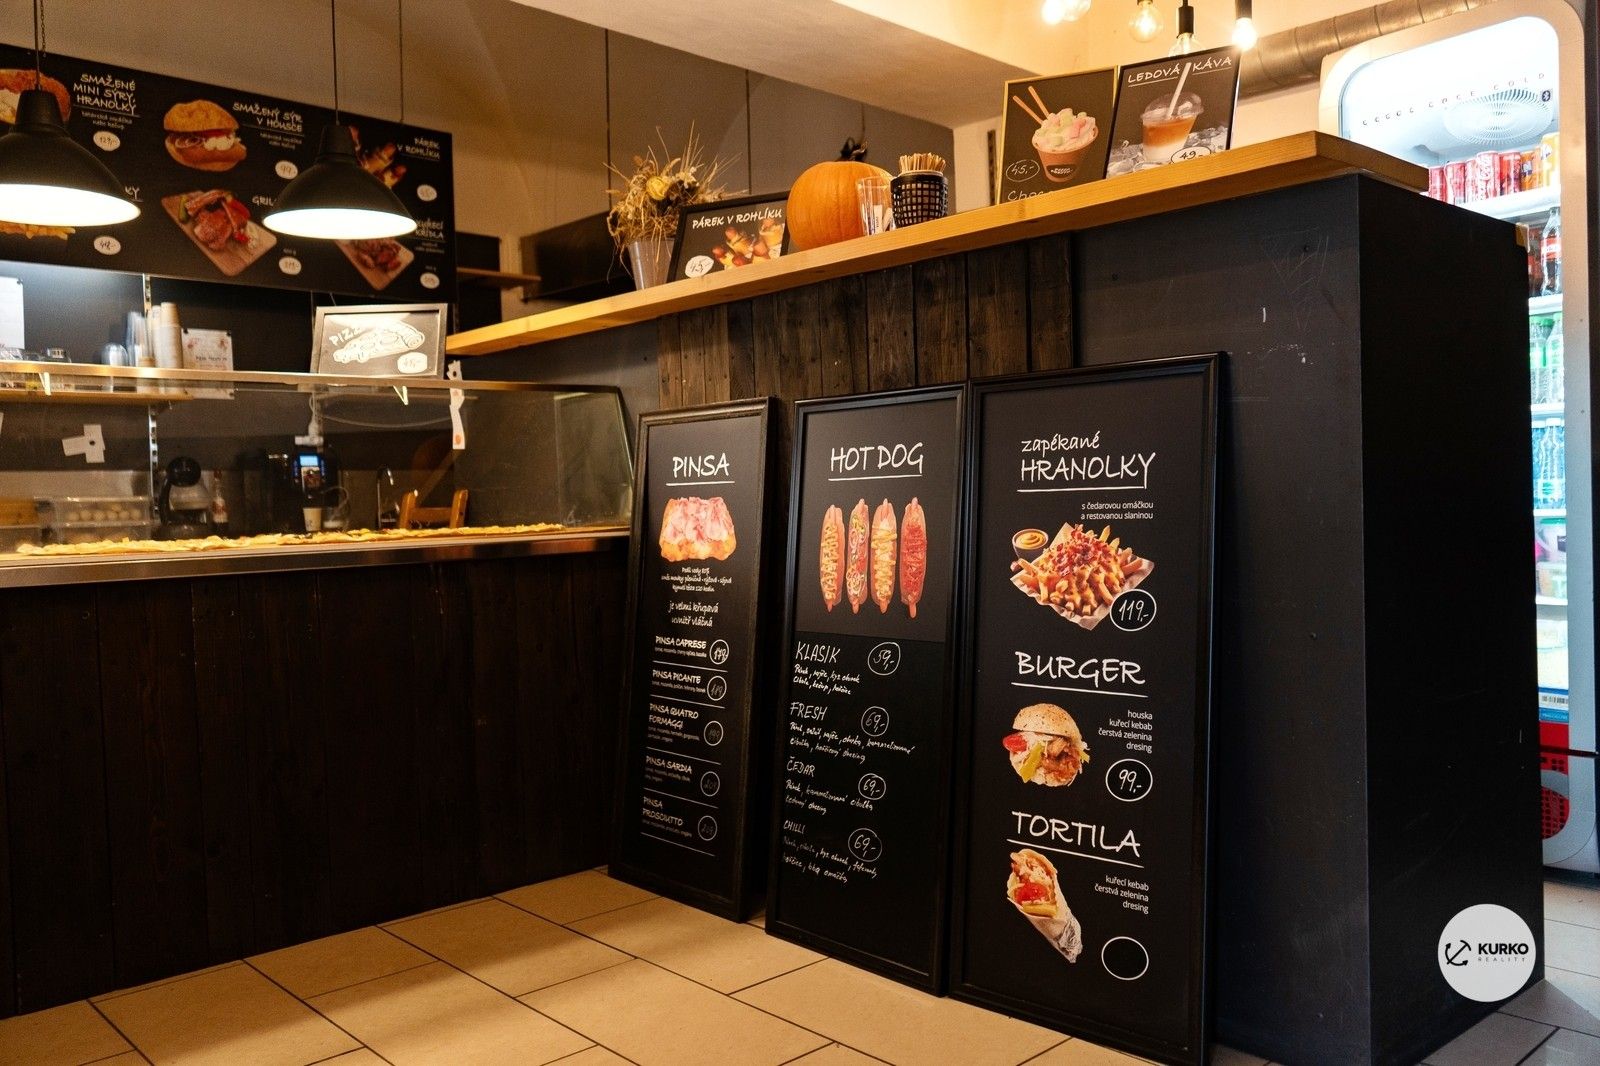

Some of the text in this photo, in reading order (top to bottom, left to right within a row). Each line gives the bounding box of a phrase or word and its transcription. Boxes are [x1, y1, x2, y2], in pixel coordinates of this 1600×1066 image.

[1127, 56, 1232, 84] LEDOVÁ KÁVA
[73, 83, 100, 98] MINI
[80, 73, 136, 92] SMAŽENÉ
[77, 94, 136, 115] HRANOLKY
[232, 103, 303, 124] SMAŽENÝ SÝR
[256, 117, 303, 132] V HOUSCE
[692, 207, 782, 229] PÁREK V ROHLÍKU
[1021, 431, 1100, 457] zapékané
[672, 452, 730, 478] PINSA
[830, 441, 924, 475] HOT DOG
[1021, 452, 1156, 489] HRANOLKY
[1086, 501, 1121, 511] čedarovou
[1122, 501, 1154, 510] omáčkou
[1086, 512, 1123, 520] restovanou
[1124, 511, 1154, 520] slaninou
[1118, 599, 1149, 622] 119,-
[655, 635, 707, 650] PINSA CAPRESE
[795, 641, 841, 664] KLASIK
[652, 669, 702, 685] PINSA PICANTE
[1015, 651, 1146, 688] BURGER
[649, 703, 699, 720] PINSA QUATRO
[790, 701, 828, 721] FRESH
[1127, 710, 1153, 720] houska
[1098, 727, 1153, 742] čerstvá zelenina
[1109, 719, 1153, 731] kuřecí kebab
[1126, 741, 1153, 753] dresing
[646, 755, 693, 774] PINSA SARDIA
[786, 755, 816, 778] ČEDAR
[1118, 769, 1142, 793] 99,-
[643, 796, 663, 809] PINSA
[783, 820, 806, 835] CHILLI
[1011, 810, 1141, 858] TORTILA
[1094, 883, 1149, 902] čerstvá zelenina
[1105, 875, 1149, 891] kuřecí kebab
[1122, 901, 1149, 915] dresing
